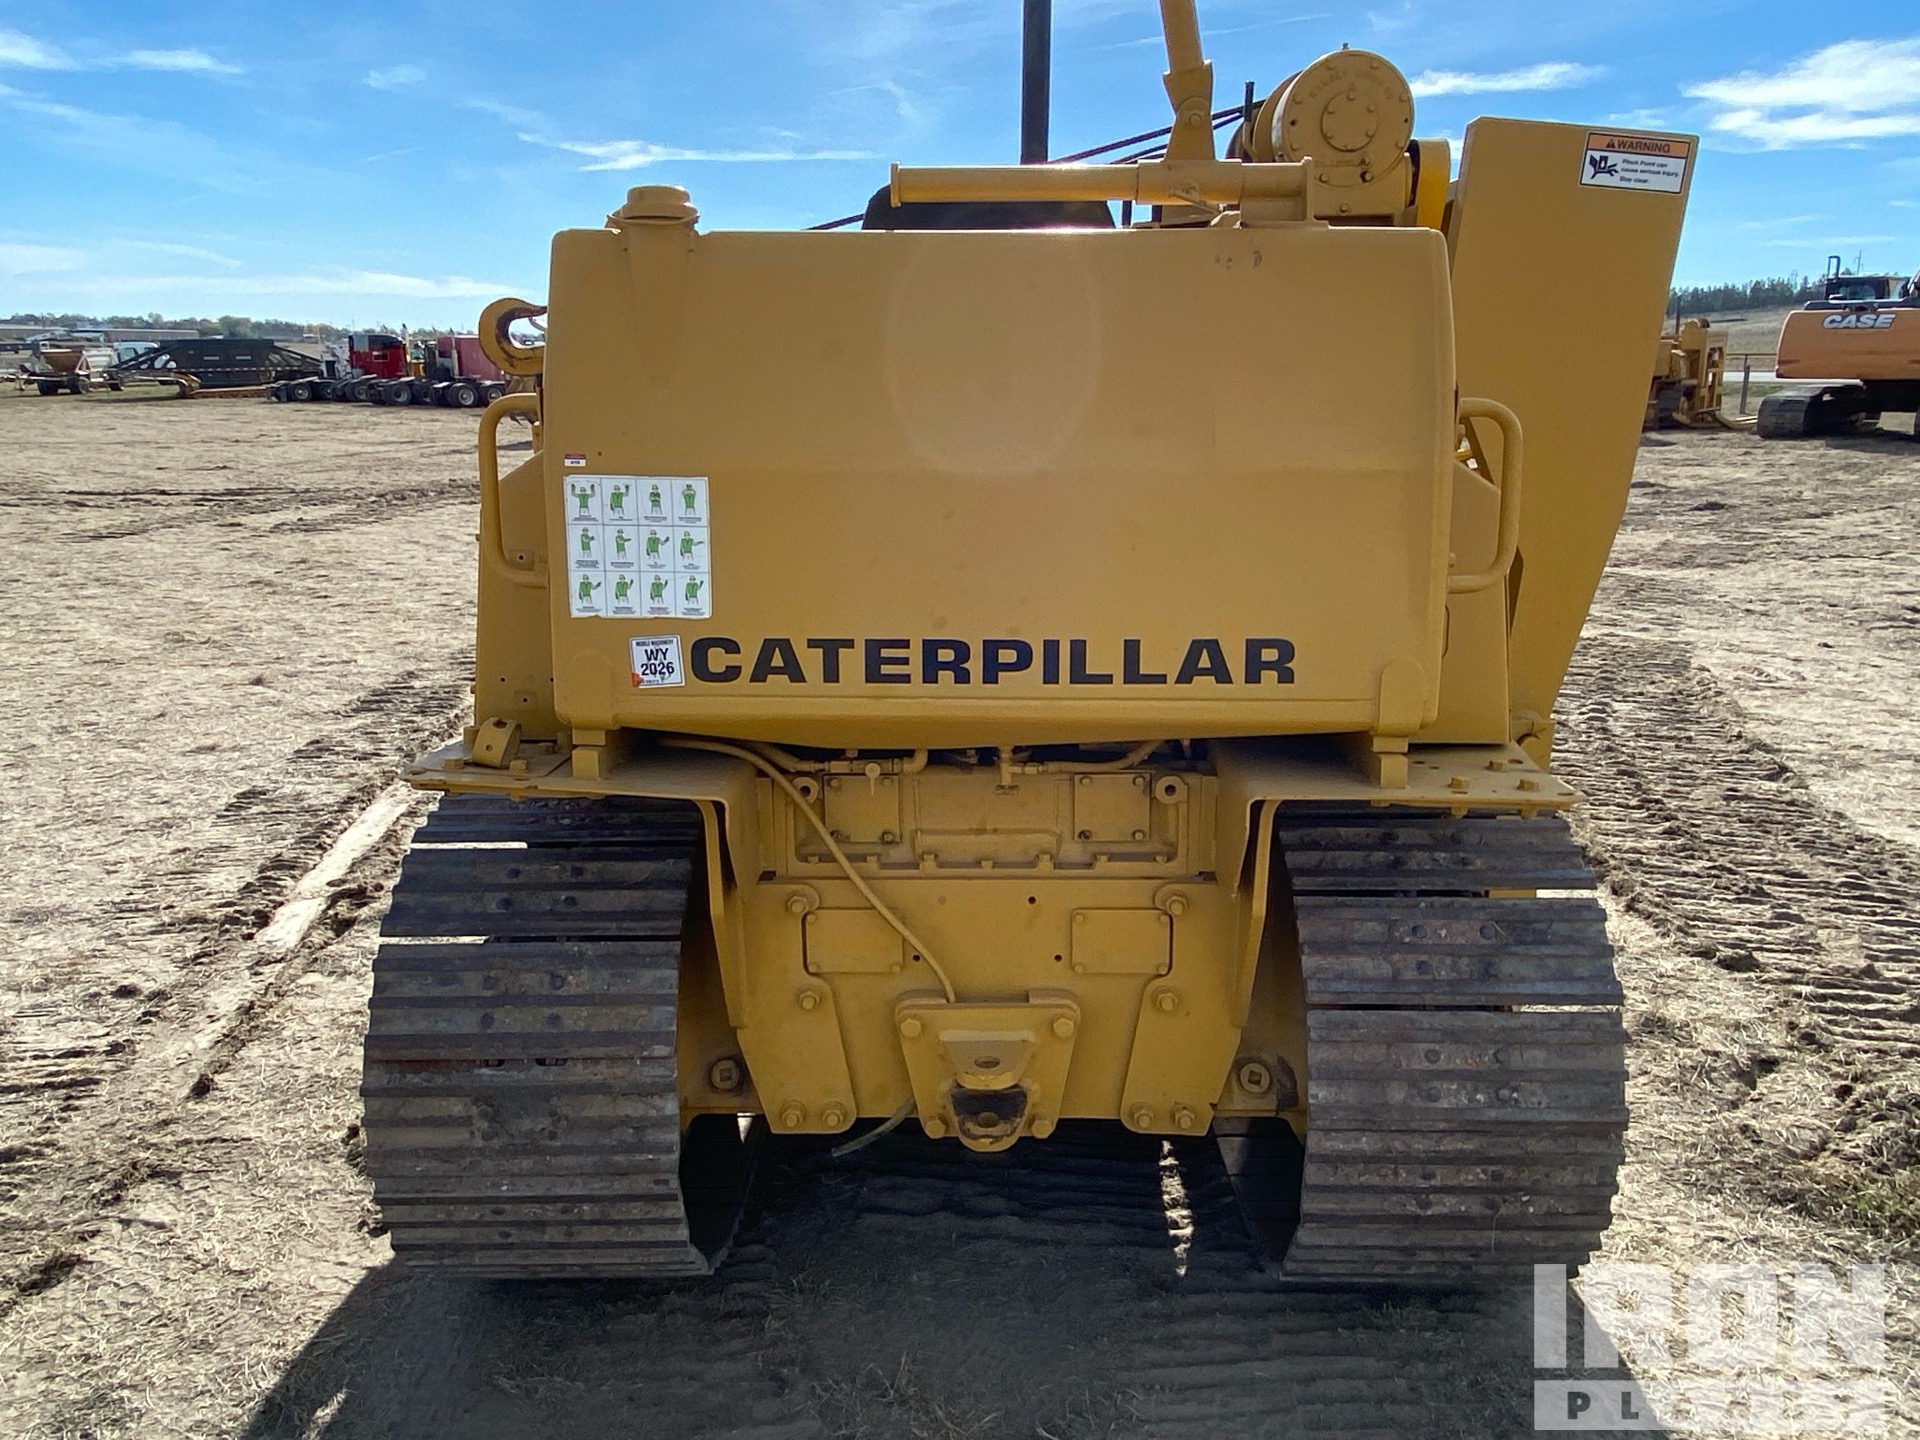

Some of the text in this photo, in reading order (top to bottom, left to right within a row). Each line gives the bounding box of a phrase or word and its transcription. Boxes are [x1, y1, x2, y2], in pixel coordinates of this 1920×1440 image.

[1617, 139, 1671, 154] WARNING
[1622, 158, 1639, 166] Pinch
[1640, 160, 1656, 168] Point
[1619, 175, 1632, 183] Stay
[1823, 314, 1896, 329] CASE
[644, 647, 669, 661] WY
[690, 636, 1296, 685] CATERPILLAR
[640, 661, 675, 676] 2026
